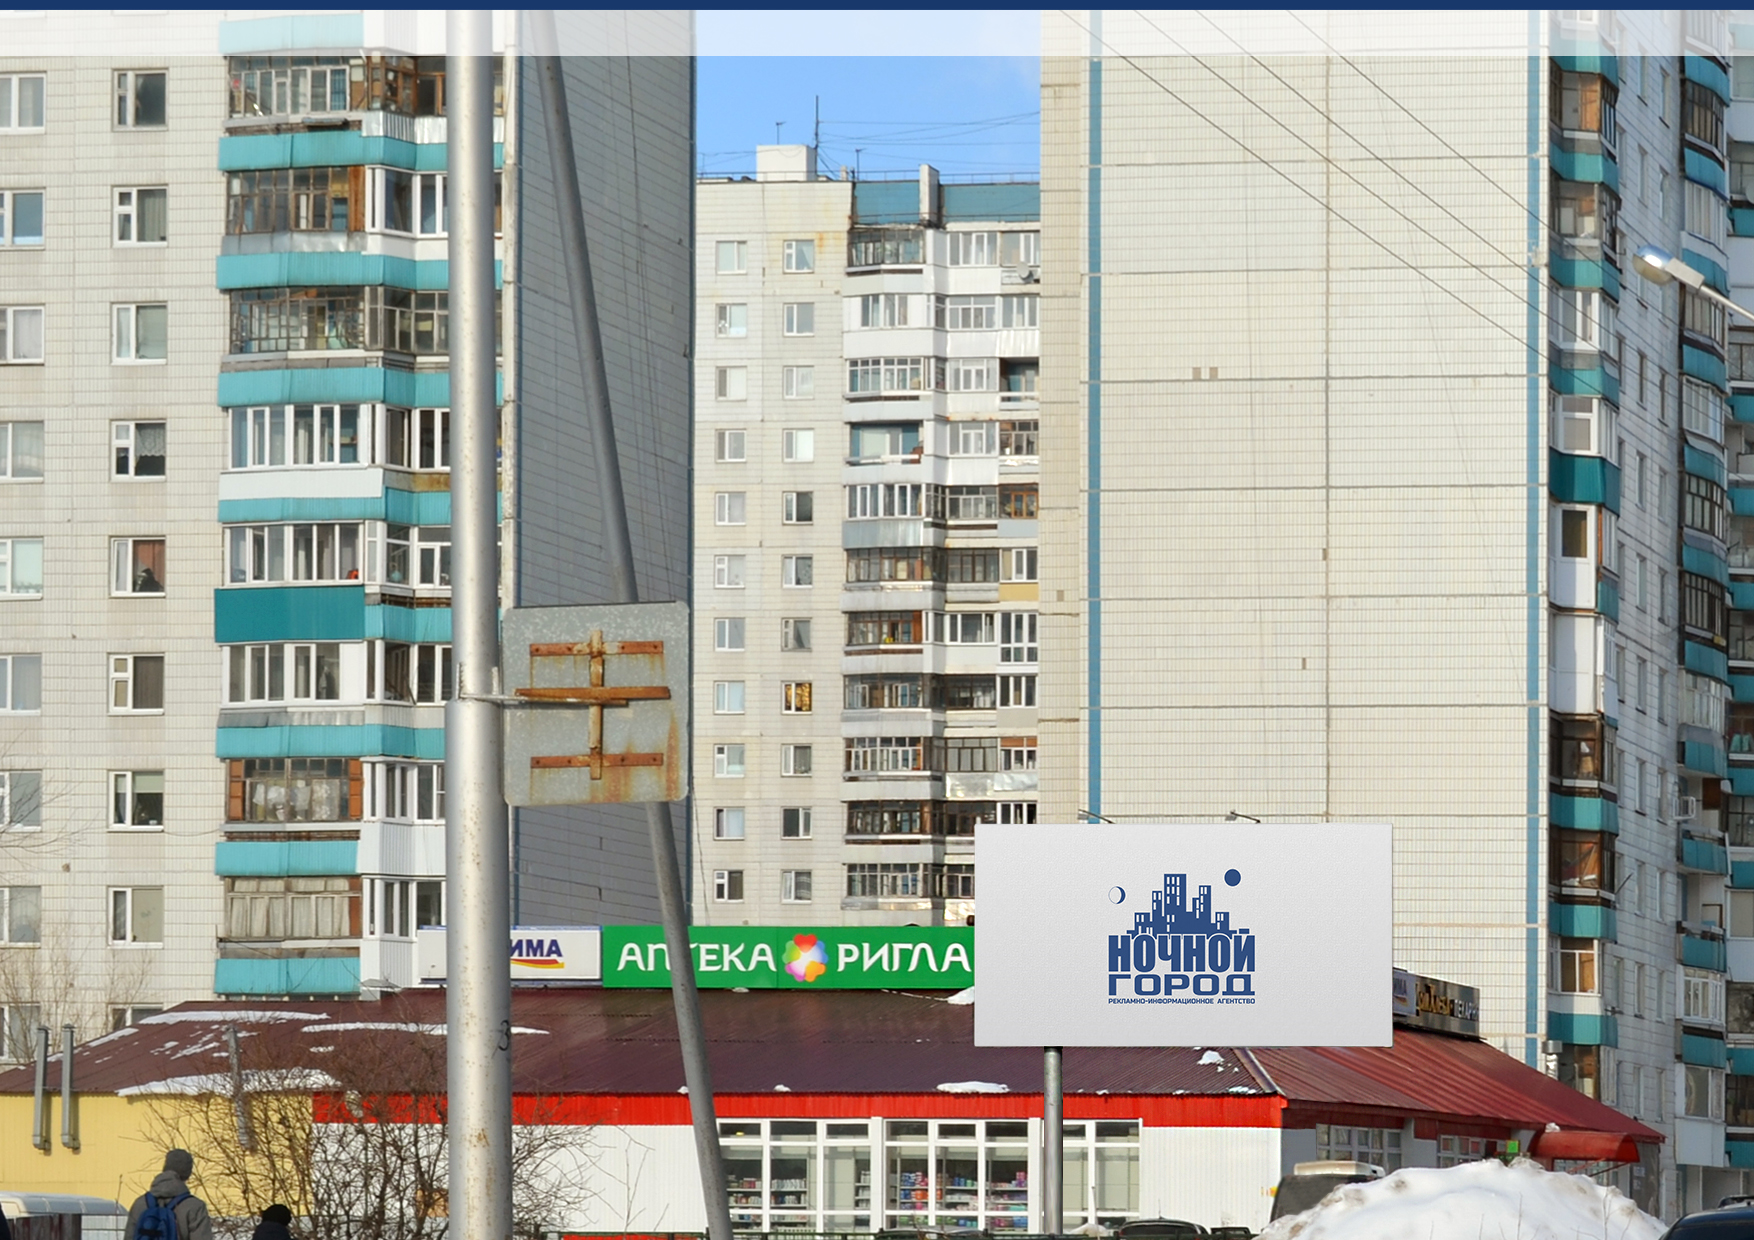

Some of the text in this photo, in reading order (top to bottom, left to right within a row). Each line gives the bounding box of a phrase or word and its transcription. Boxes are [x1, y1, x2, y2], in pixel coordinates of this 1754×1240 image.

[616, 942, 972, 973] АПЕКА РИГЛА
[1108, 928, 1256, 973] НОЧНОЙ
[1108, 974, 1256, 996] ГОРОД
[1108, 997, 1256, 1005] РЕКЛАМНО-ИНФОРМАЦИОННОЕ АГЕНТСТВО
